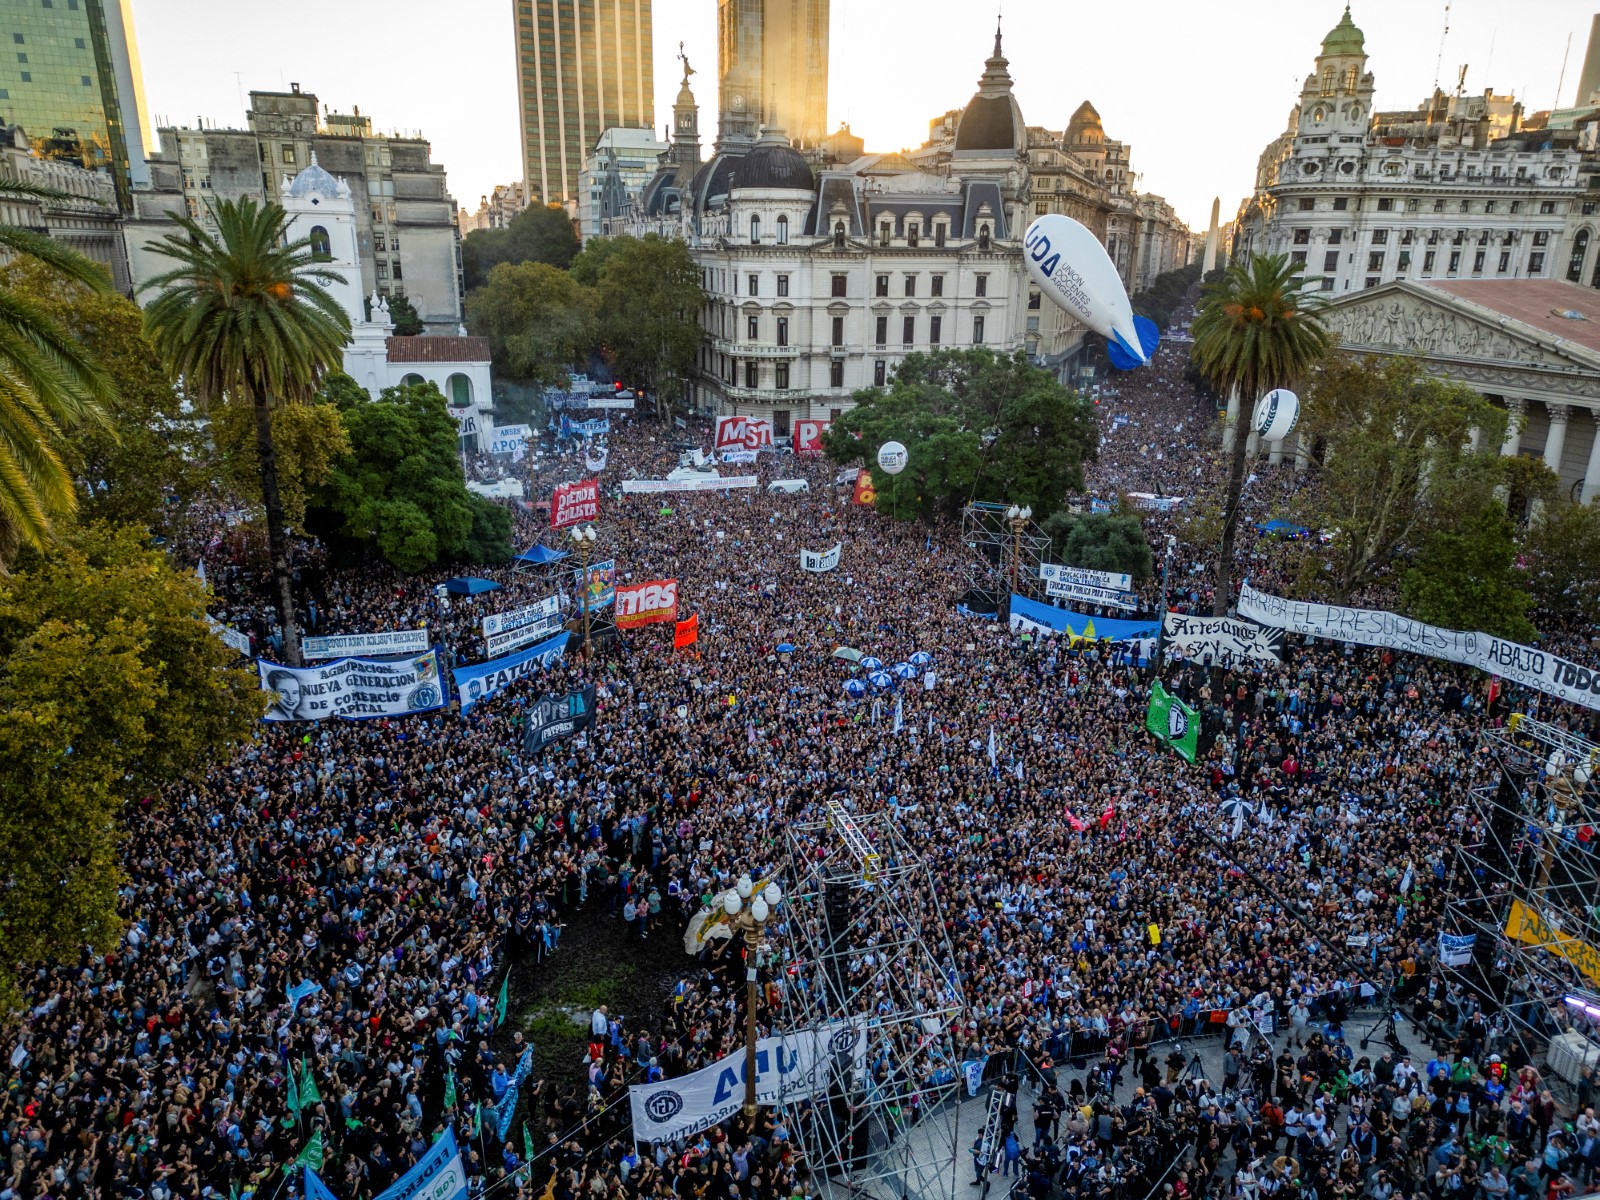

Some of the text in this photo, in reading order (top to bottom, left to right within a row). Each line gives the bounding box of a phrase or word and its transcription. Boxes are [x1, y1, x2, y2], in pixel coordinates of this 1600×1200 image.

[1025, 225, 1061, 277] UDA
[1055, 268, 1091, 305] DOCENTES
[1062, 262, 1085, 287] UNION
[1050, 277, 1092, 318] ARGENTINOS
[722, 421, 771, 447] MST
[624, 583, 677, 615] mas
[1293, 604, 1315, 625] EL
[1488, 640, 1545, 675] ABAJO
[484, 654, 544, 692] FATUN
[1295, 625, 1309, 633] NO
[1362, 633, 1374, 642] LA
[1379, 636, 1396, 647] LEY
[1461, 654, 1468, 662] Y
[1479, 657, 1490, 671] EL
[1502, 666, 1566, 698] PROTOCOLO
[1578, 694, 1594, 707] DE
[301, 680, 341, 697] NUEVA
[310, 699, 328, 710] DE
